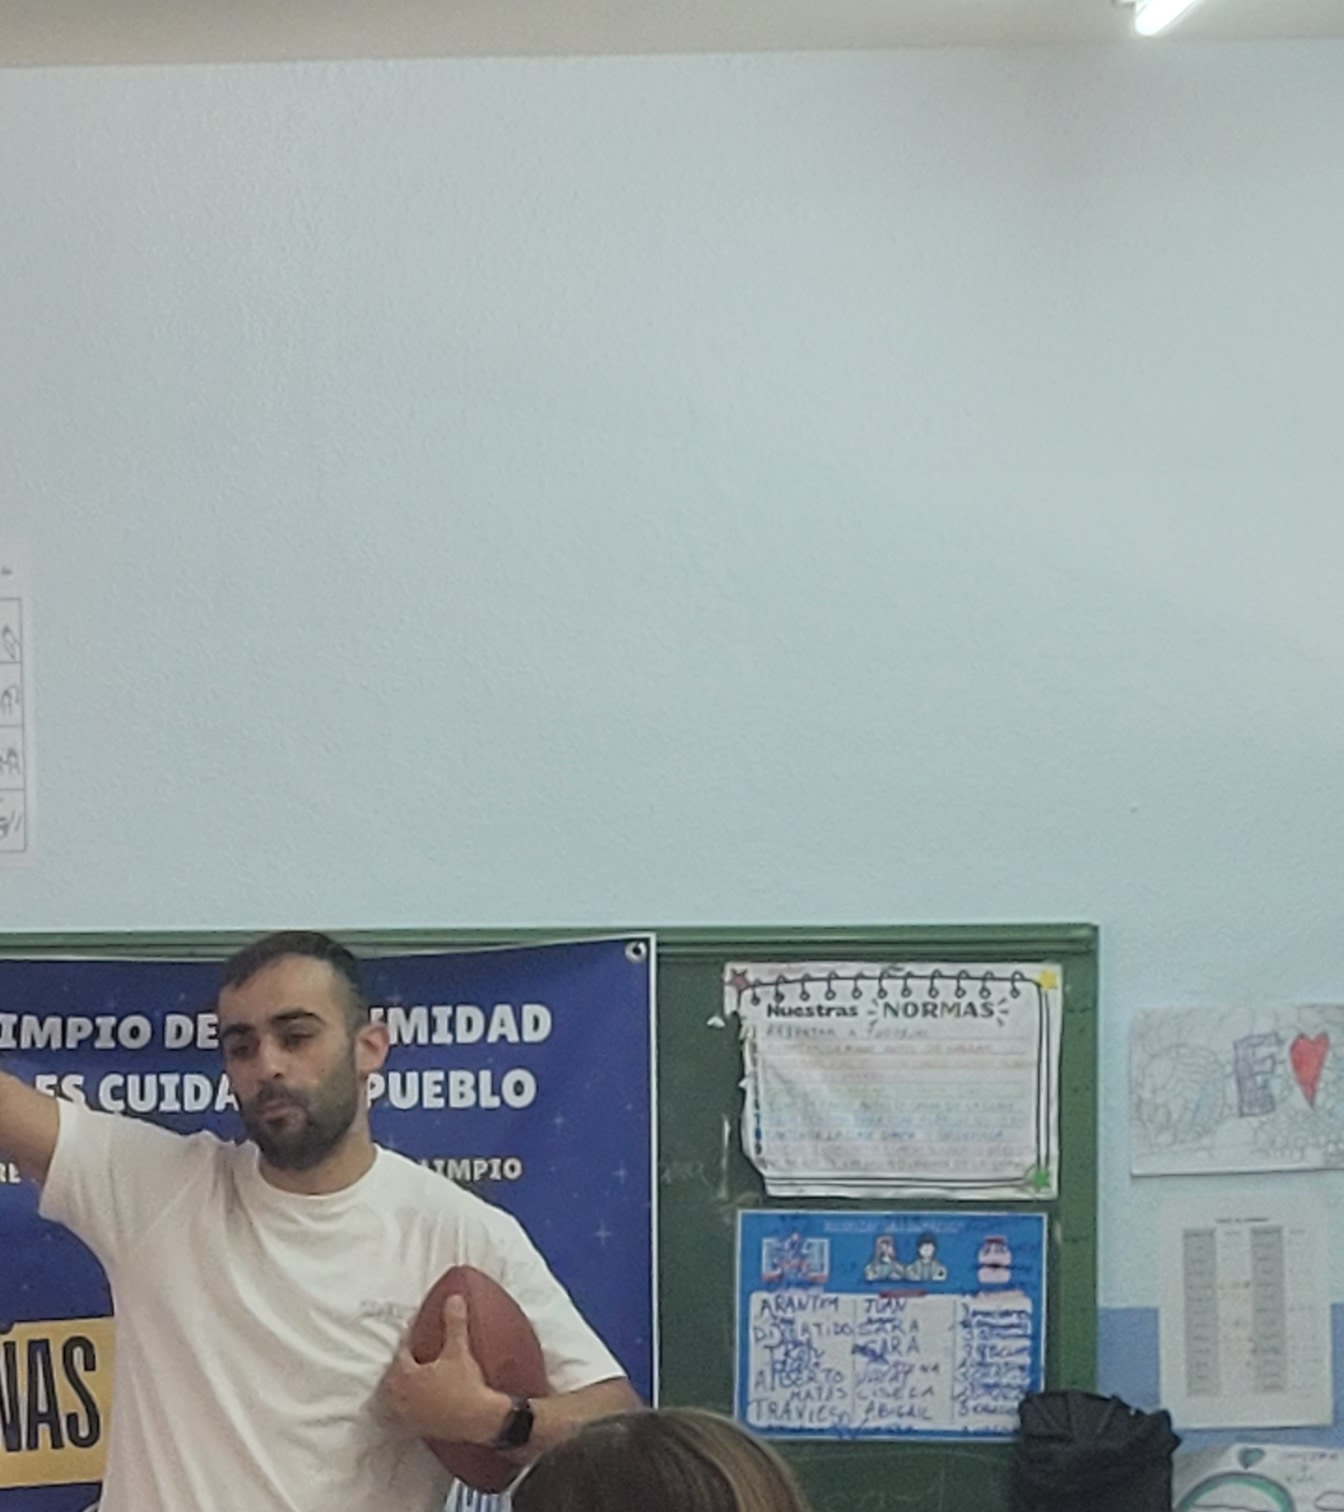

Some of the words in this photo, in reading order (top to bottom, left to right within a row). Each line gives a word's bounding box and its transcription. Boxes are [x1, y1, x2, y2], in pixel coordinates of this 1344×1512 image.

[766, 1002, 860, 1019] Nuestras
[882, 1000, 996, 1019] NORMAS
[164, 1013, 219, 1050] DE
[366, 1069, 537, 1110] PUEBLO
